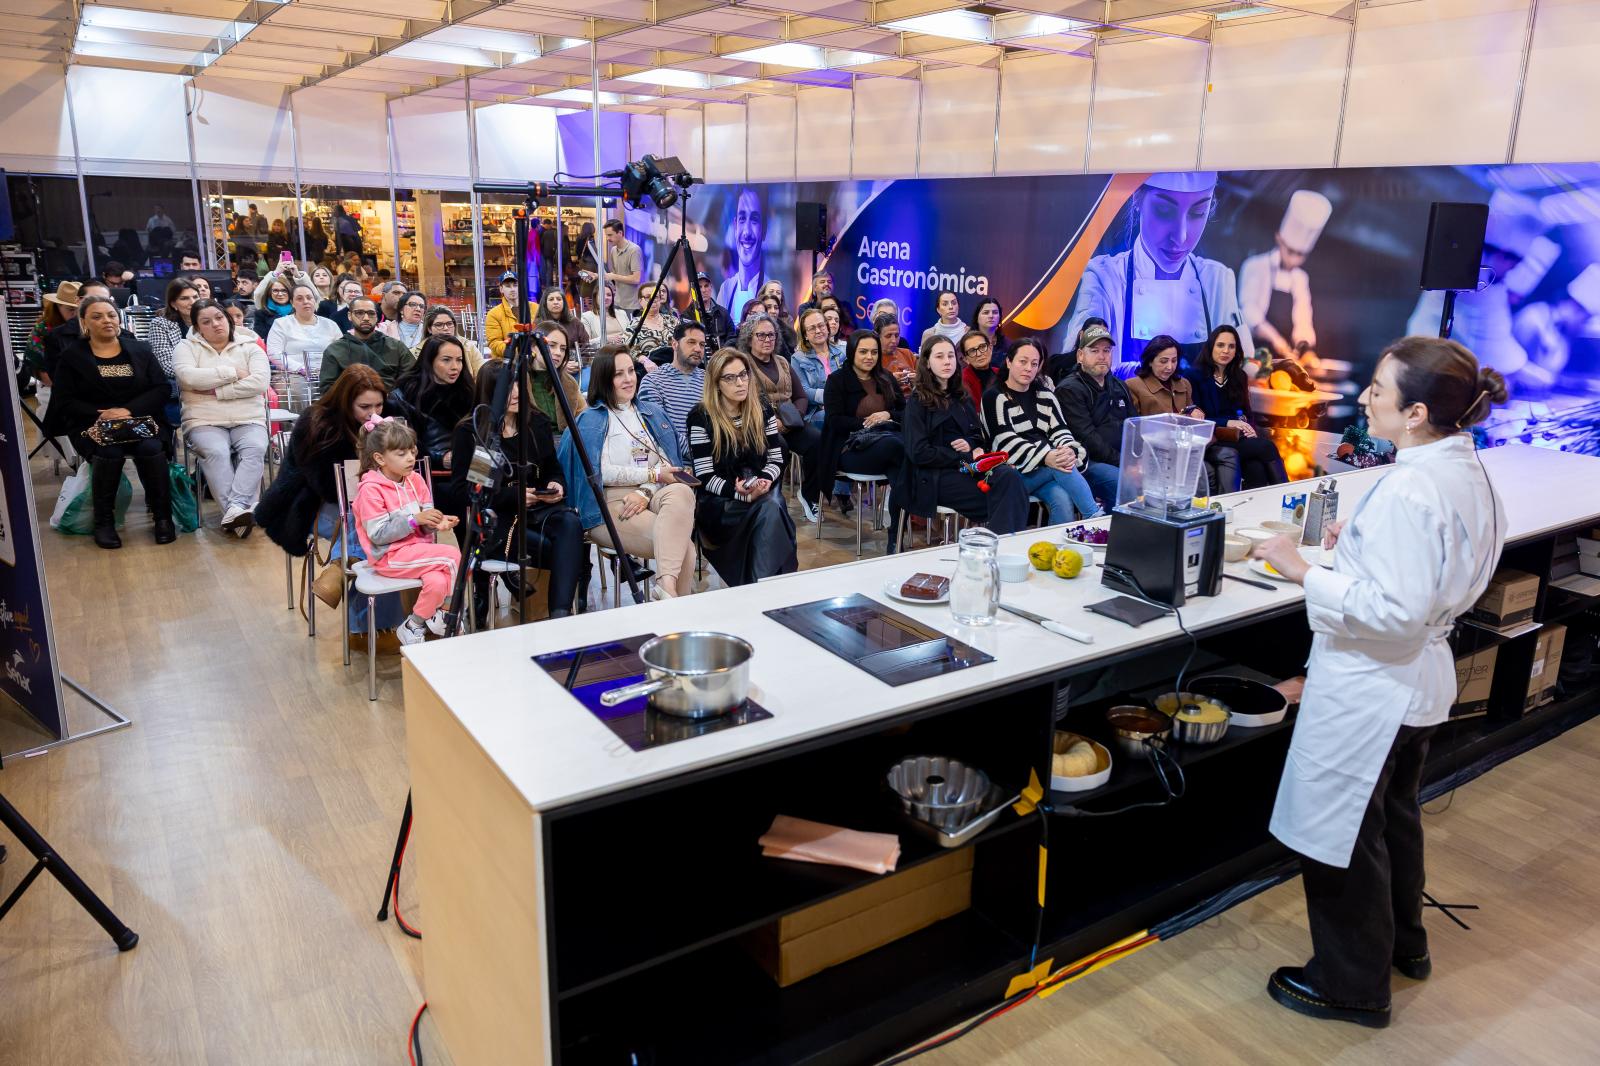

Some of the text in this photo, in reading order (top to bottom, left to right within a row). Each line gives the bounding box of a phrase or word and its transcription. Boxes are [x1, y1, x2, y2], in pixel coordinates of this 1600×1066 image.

[857, 236, 910, 260] Arena
[857, 262, 988, 295] Gastronômica
[855, 295, 912, 326] Sec
